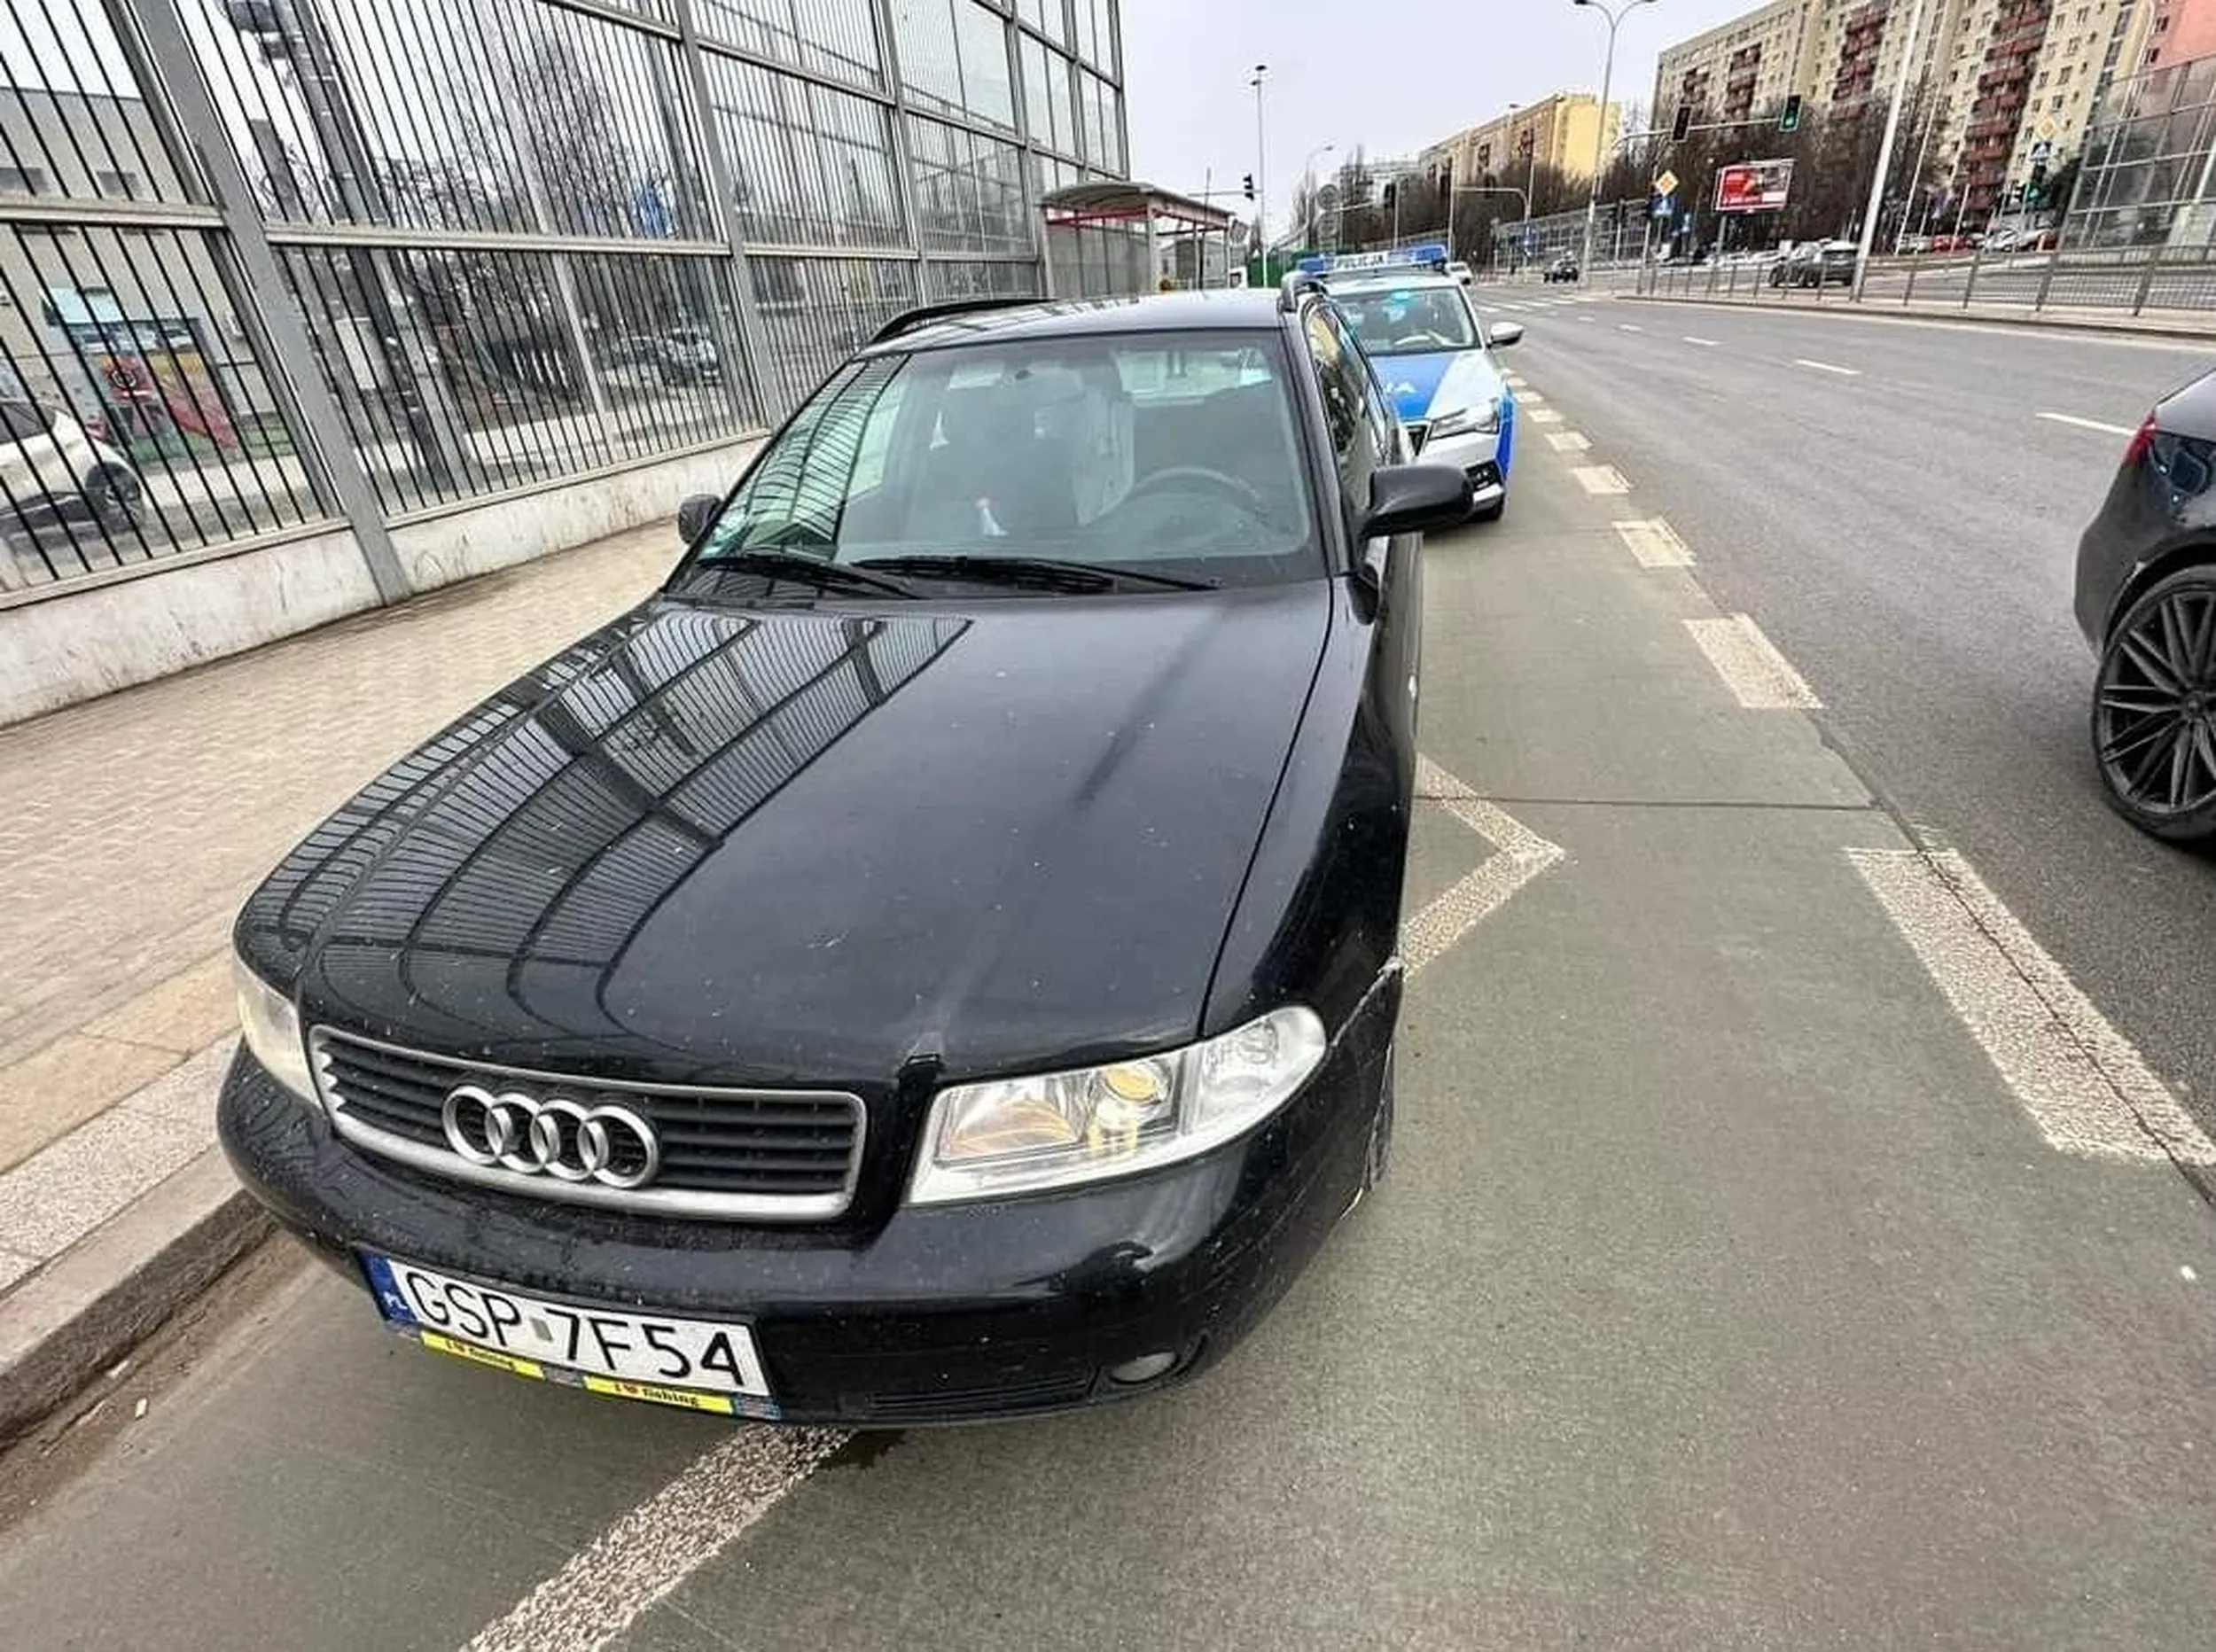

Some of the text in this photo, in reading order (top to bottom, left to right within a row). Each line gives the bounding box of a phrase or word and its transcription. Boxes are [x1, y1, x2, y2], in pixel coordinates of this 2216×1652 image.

[1336, 253, 1384, 269] POLICJA
[407, 1271, 521, 1346] GSP
[543, 1308, 745, 1387] 7F54
